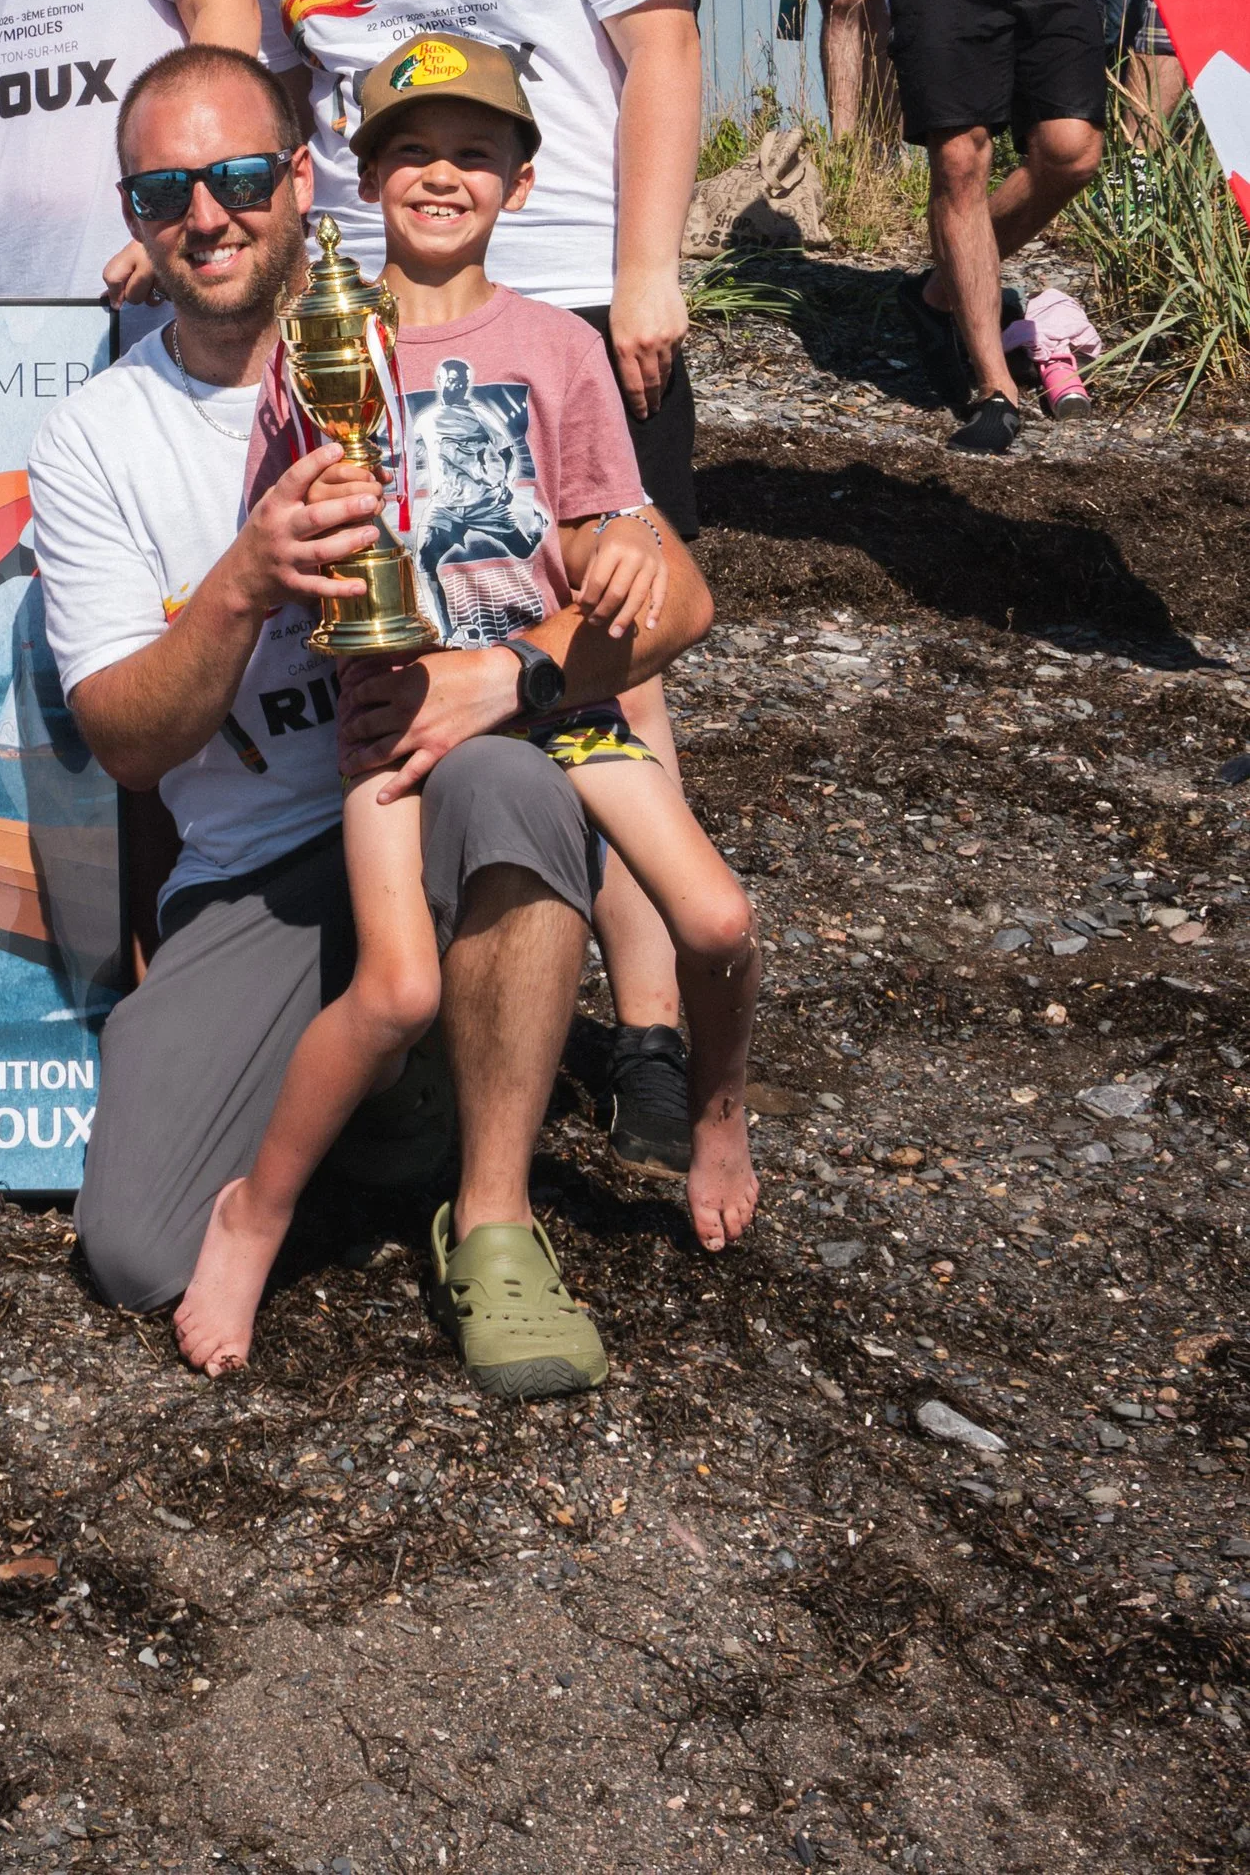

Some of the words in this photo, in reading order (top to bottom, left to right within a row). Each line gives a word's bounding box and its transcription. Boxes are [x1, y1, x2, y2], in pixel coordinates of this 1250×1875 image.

[47, 3, 84, 17] ÉDITION
[367, 23, 377, 32] 22
[379, 14, 404, 29] AOÛT
[406, 12, 425, 24] 2026
[457, 1, 498, 15] ÉDITION
[419, 43, 451, 56] Bass
[422, 54, 444, 66] Pro
[422, 64, 462, 77] Shops
[714, 213, 752, 231] SHOP
[270, 629, 283, 641] 22
